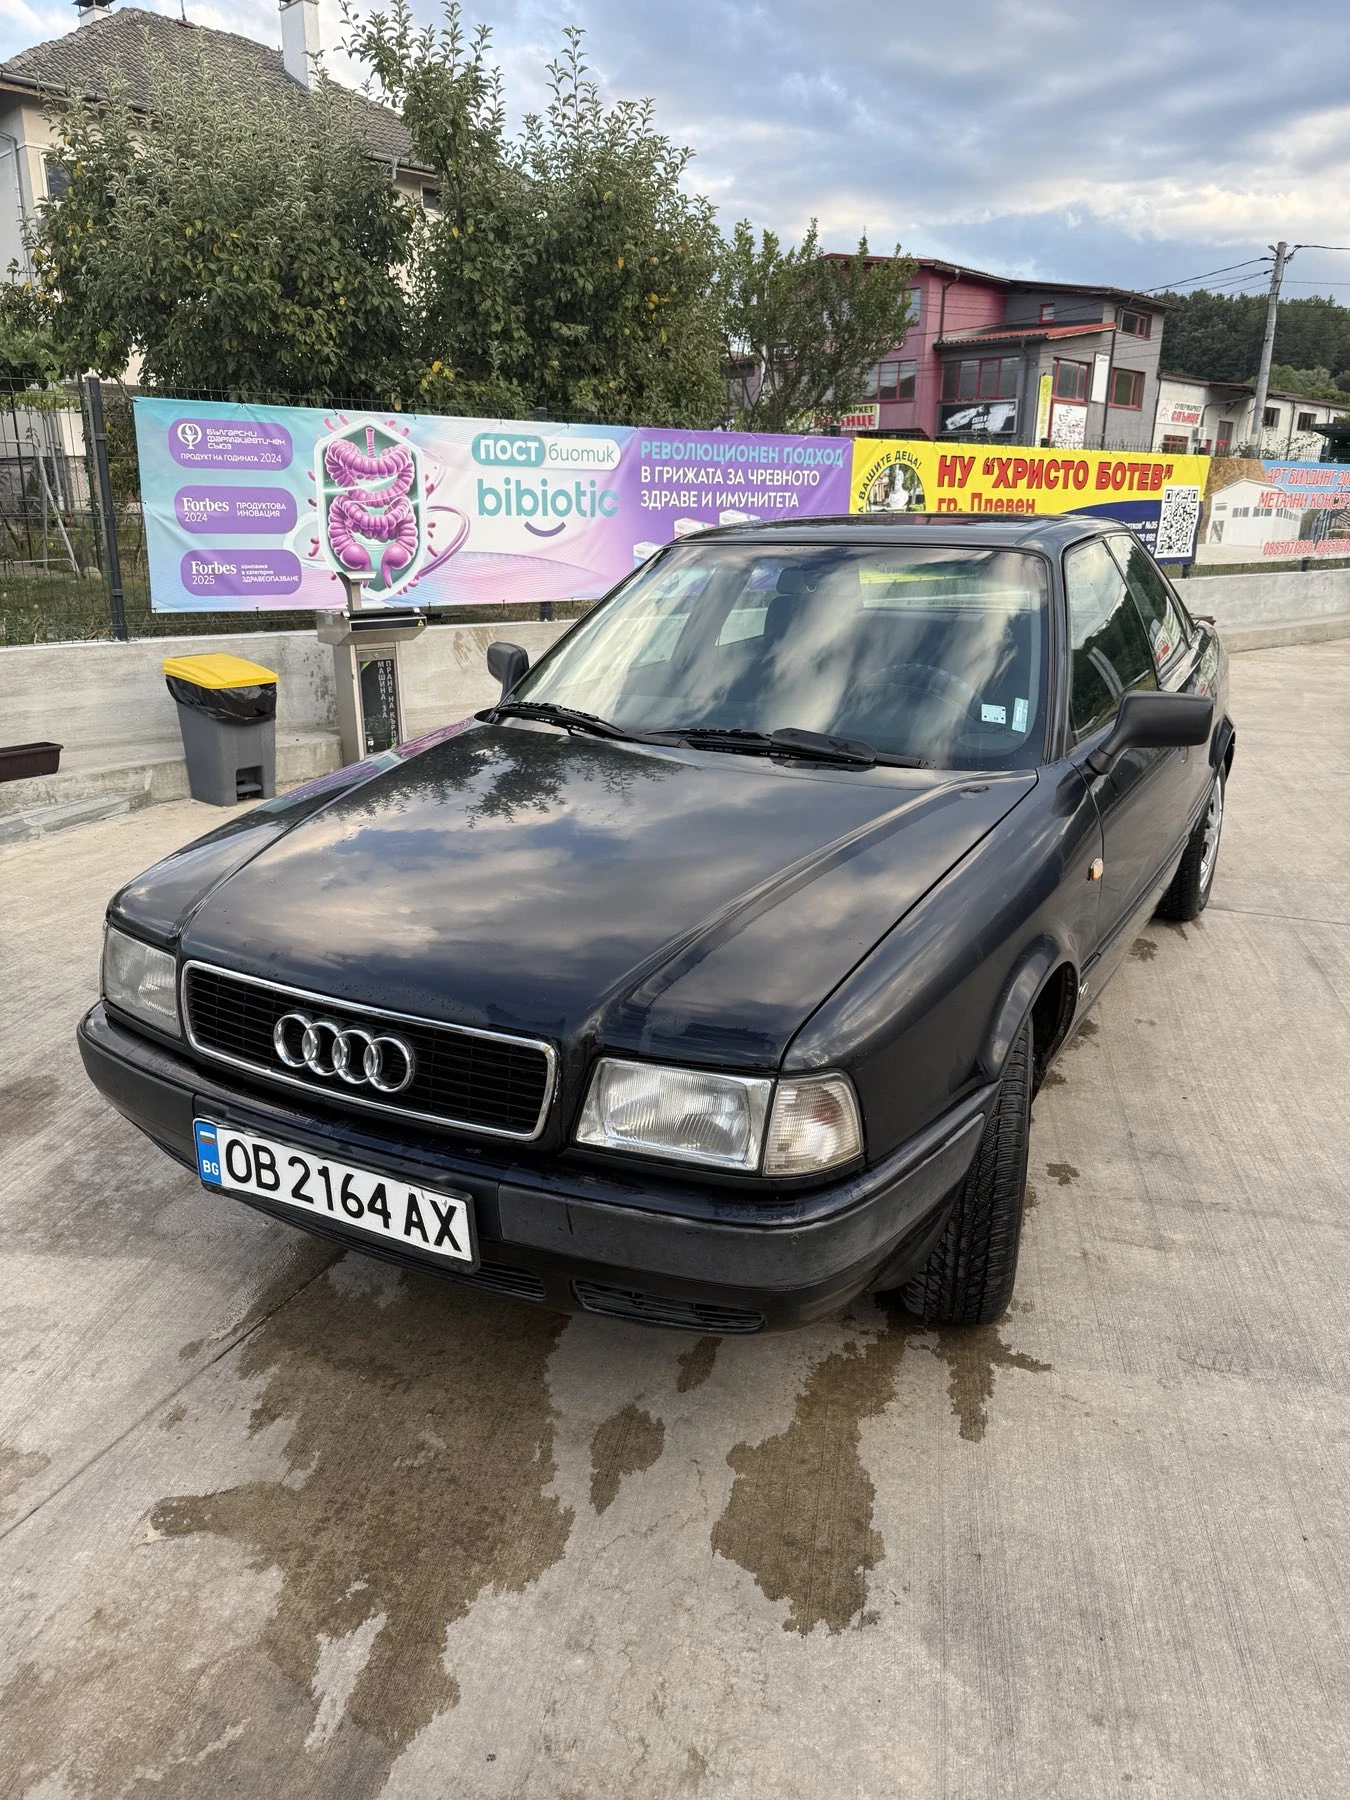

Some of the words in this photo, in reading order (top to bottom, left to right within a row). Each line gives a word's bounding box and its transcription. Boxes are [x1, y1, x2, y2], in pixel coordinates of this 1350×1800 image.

[1171, 411, 1201, 426] СЛЪНЦЕ
[180, 452, 212, 461] ПРОДУКТ
[224, 455, 258, 463] ГОДИНАТА
[260, 453, 282, 463] 2024
[479, 438, 539, 462] ПОСТ
[640, 441, 779, 465] РЕВОЛЮЦИОНЕН
[783, 447, 843, 468] ПОДХОД
[641, 467, 652, 483] В
[655, 467, 724, 485] ГРИЖАТА
[726, 469, 745, 486] ЗА
[748, 470, 820, 487] ЧРЕВНОТО
[858, 453, 892, 500] ВАШИТЕ
[894, 450, 922, 470] ДЕЦА!
[937, 454, 976, 489] НУ
[1265, 467, 1288, 484] АРТ
[1287, 468, 1338, 488] БИЛДИНГ
[181, 497, 230, 512] Forbes
[236, 501, 286, 511] ПРОДУКТОВА
[476, 478, 619, 518] bibiotic
[640, 490, 698, 510] ЗДРАВЕ
[702, 491, 712, 507] И
[716, 491, 799, 508] ИМУНИТЕТА
[937, 497, 962, 512] гр.
[970, 492, 1036, 513] Плевен
[1258, 491, 1308, 509] МЕТАЛНИ
[184, 512, 208, 522] 2024
[237, 510, 280, 518] ИНОВАЦИЯ
[190, 561, 237, 575] Forbes
[192, 575, 215, 585] 2025
[241, 575, 299, 583] ЗДРАВЕОПАЗВАНЕ
[377, 661, 386, 701] МАШИНА
[382, 705, 388, 718] ЗА
[388, 696, 395, 709] НА
[202, 1159, 220, 1176] BG
[287, 1155, 392, 1230] 2164
[403, 1192, 463, 1253] AX
